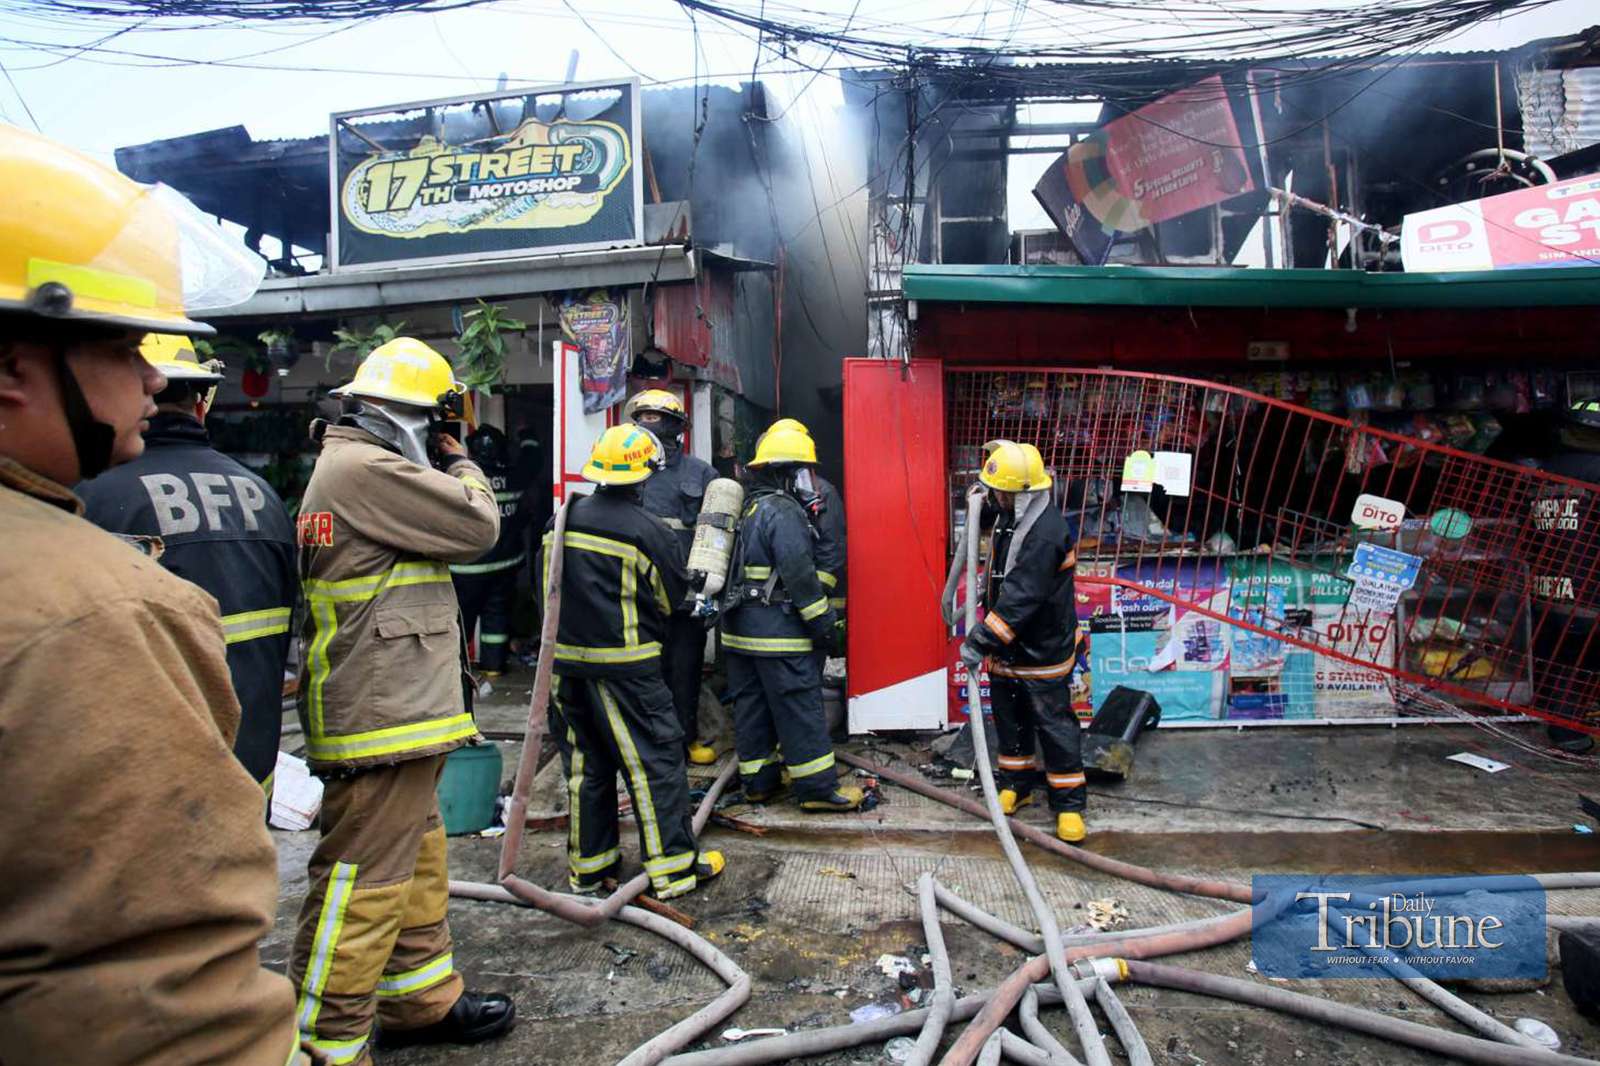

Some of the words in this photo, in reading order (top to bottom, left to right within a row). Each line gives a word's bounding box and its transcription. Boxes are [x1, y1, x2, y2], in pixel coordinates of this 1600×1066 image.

[365, 157, 429, 213] 17
[428, 145, 584, 184] STREET
[419, 186, 451, 205] TH
[469, 176, 583, 200] MOTOSHOP
[1419, 242, 1474, 252] DITO
[139, 472, 265, 536] BFP
[1362, 507, 1398, 524] DITO
[1327, 623, 1387, 643] DITO
